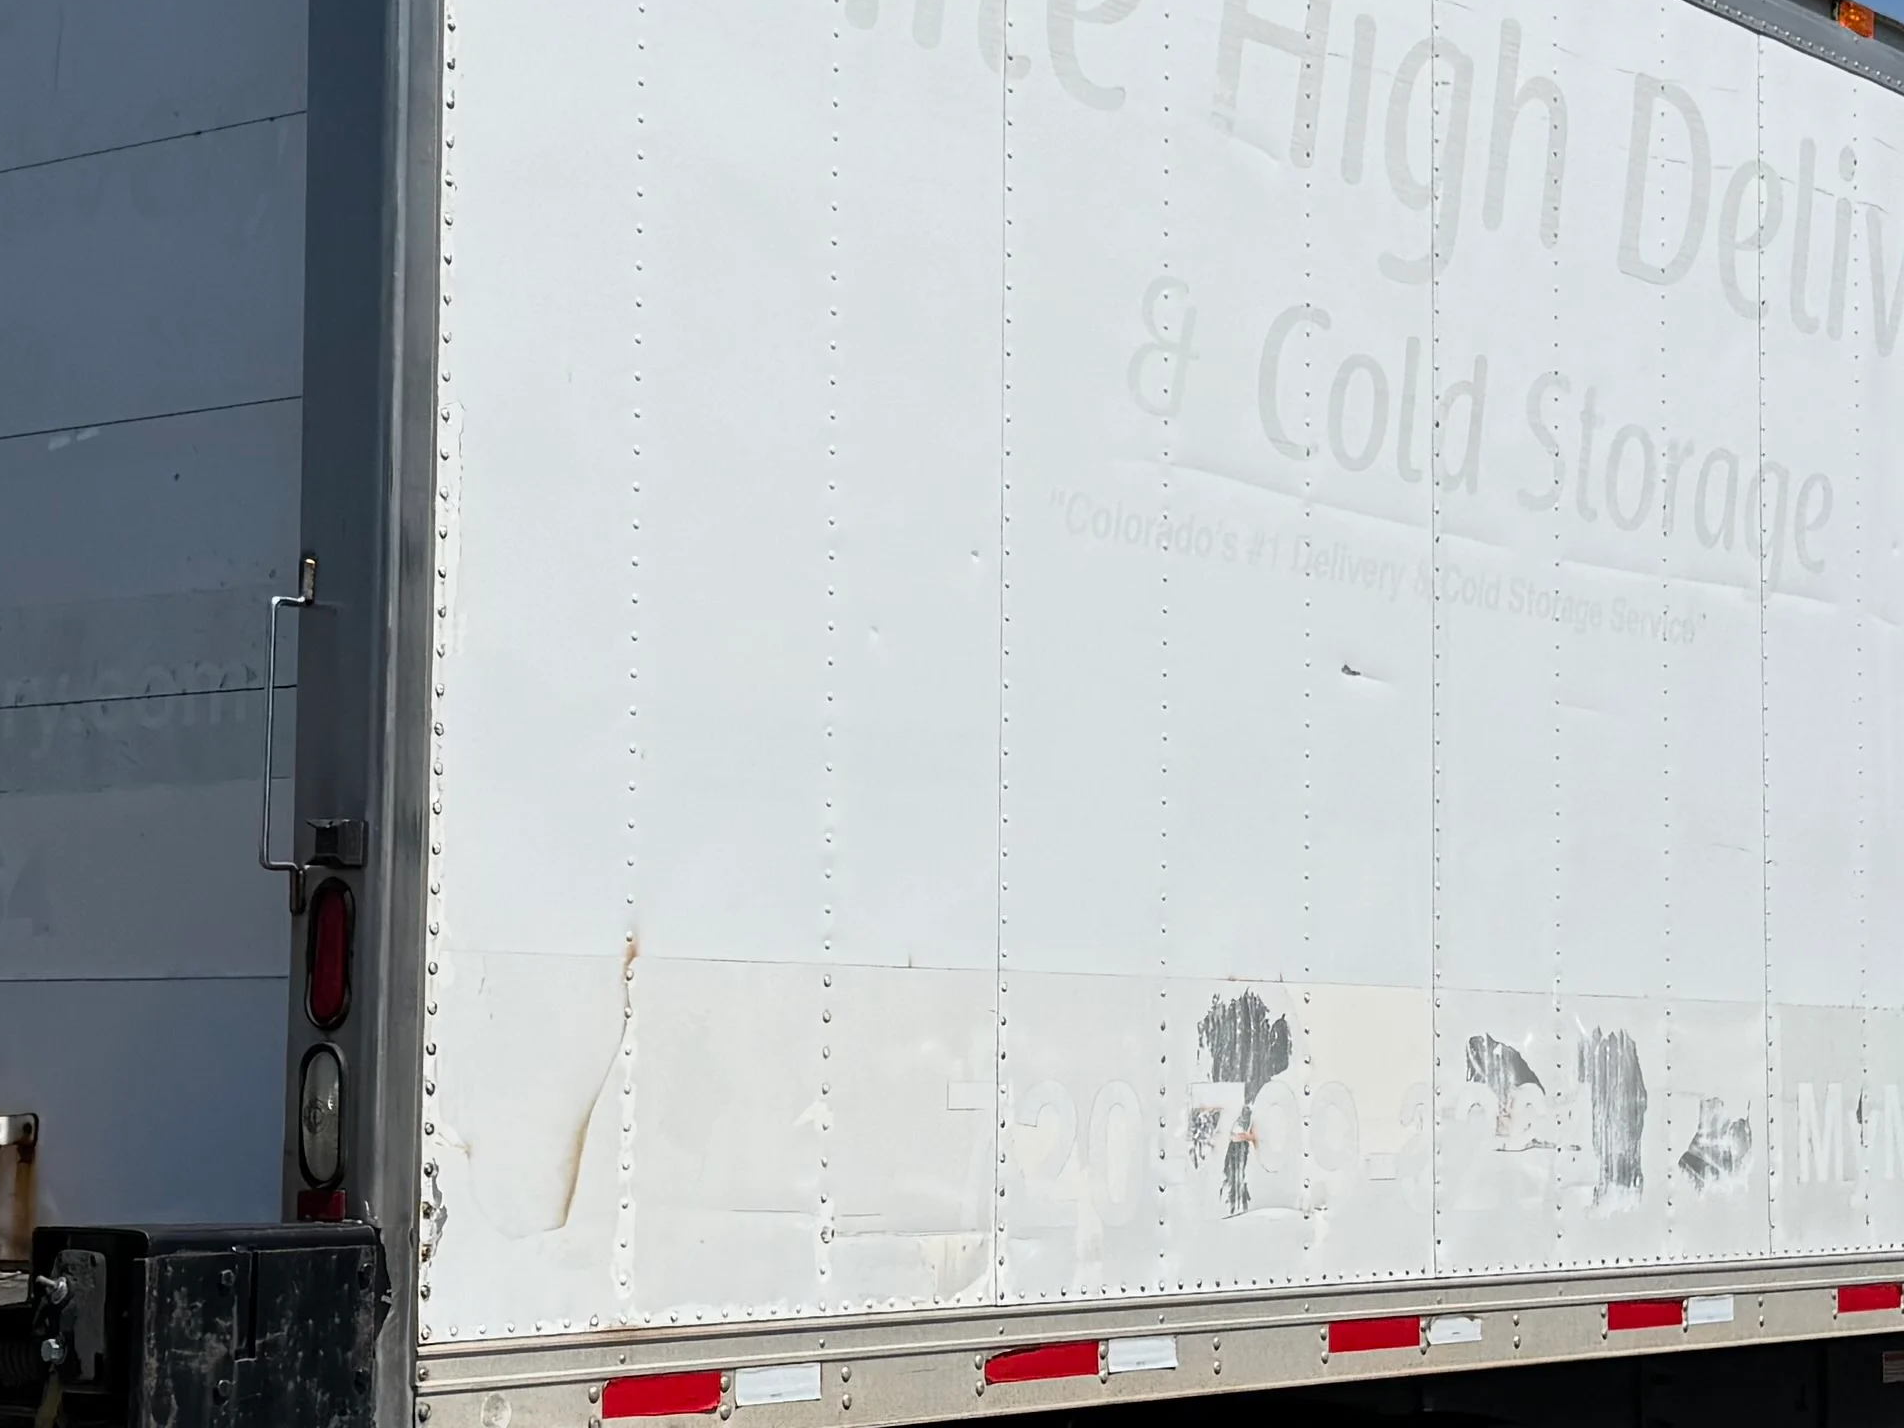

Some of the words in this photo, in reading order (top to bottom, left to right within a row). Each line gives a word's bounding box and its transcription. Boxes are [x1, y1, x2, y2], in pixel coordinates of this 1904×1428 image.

[1127, 274, 1202, 418] &
[1257, 304, 1488, 496] Cold
[1527, 365, 1834, 587] Storage
[1247, 533, 1282, 573] #1
[1291, 533, 1404, 603] Delivery
[1412, 566, 1433, 598] &
[1438, 562, 1498, 613] Cold
[1507, 575, 1603, 633] Storage
